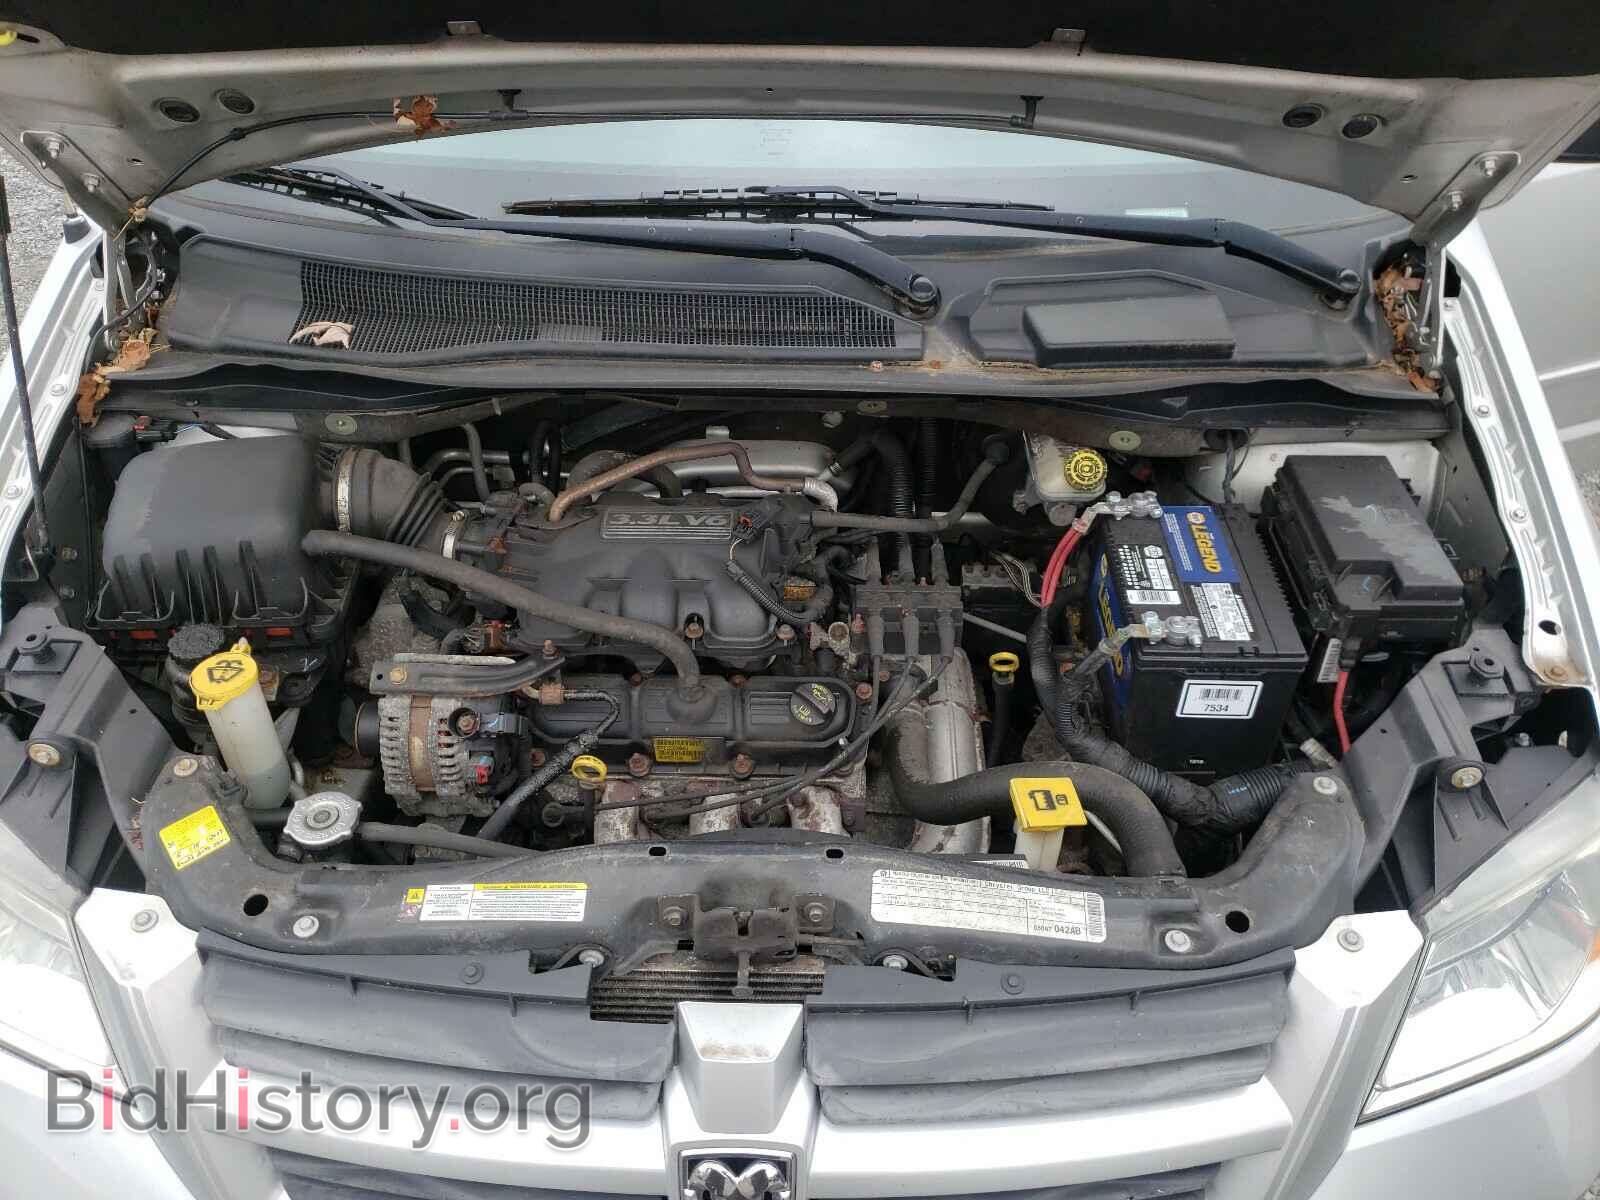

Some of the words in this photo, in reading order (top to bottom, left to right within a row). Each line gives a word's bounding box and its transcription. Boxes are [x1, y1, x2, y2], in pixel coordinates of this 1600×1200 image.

[608, 513, 681, 526] 3.3L
[684, 514, 728, 526] V6
[1191, 523, 1222, 574] LEGEND
[1204, 703, 1230, 713] 7534
